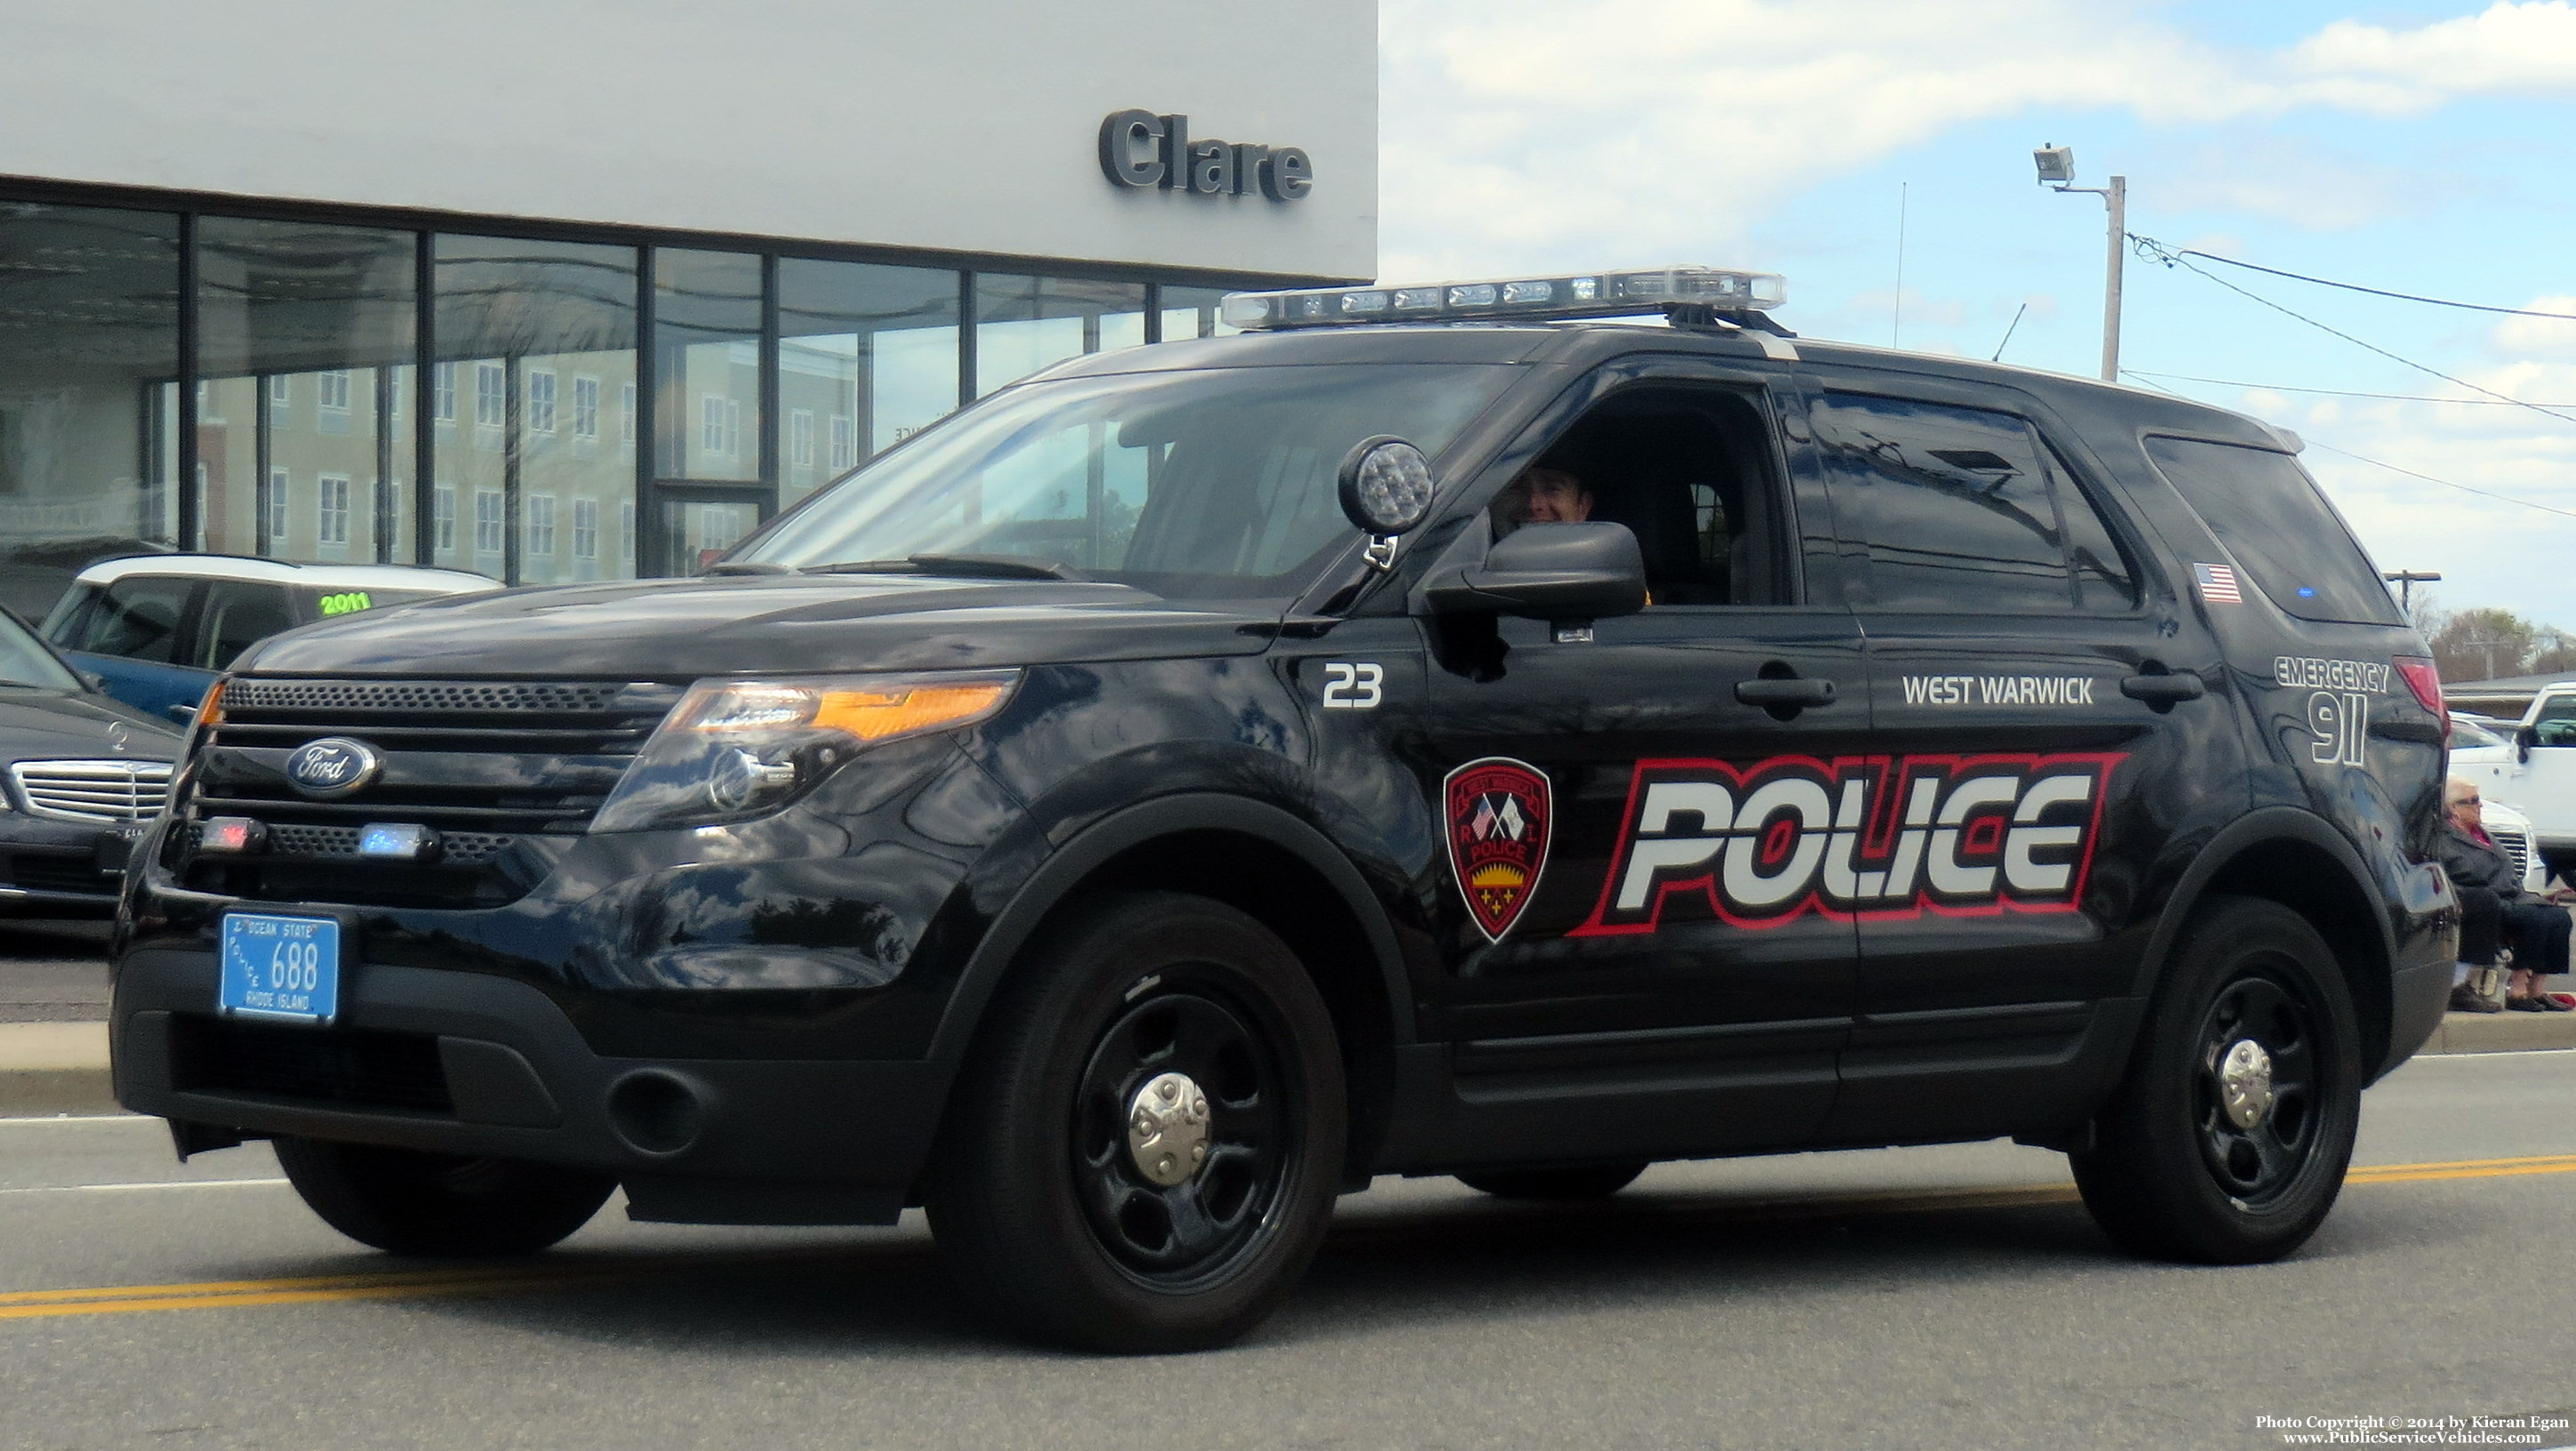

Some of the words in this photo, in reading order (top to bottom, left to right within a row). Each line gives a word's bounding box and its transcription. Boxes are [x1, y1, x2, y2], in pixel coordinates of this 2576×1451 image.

[1099, 108, 1313, 202] Clare
[321, 592, 370, 614] 2011
[1324, 663, 1383, 708] 23
[1902, 676, 1974, 704] WEST
[1979, 676, 2093, 704] WARWICK
[2275, 656, 2389, 693] EMERGENCY
[2308, 691, 2367, 766] 911
[298, 746, 349, 780] Ford
[1471, 840, 1527, 862] POLICE
[1614, 774, 2093, 910] POLICE
[284, 924, 314, 938] STATE
[272, 941, 317, 990] 688
[246, 990, 274, 1007] RHODE
[278, 994, 309, 1010] ISLAND
